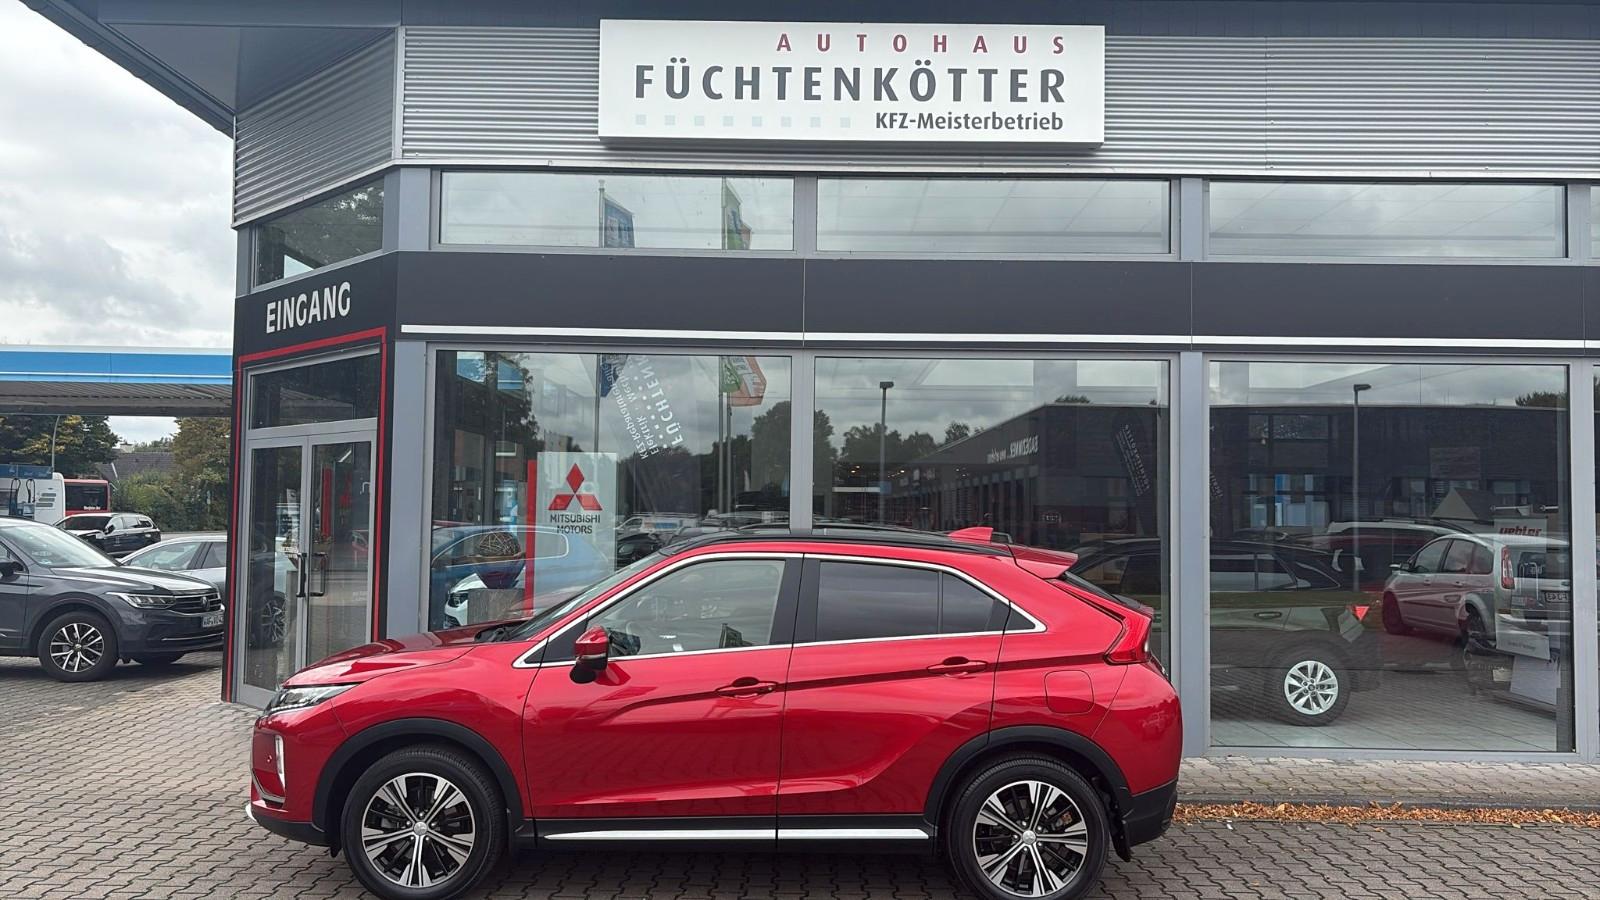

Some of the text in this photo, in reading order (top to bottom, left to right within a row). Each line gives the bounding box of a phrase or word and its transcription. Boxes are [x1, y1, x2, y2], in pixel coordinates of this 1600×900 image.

[776, 33, 1064, 54] AUTOHAUS
[635, 57, 1065, 103] FÜCHTENKÖTTER
[876, 112, 1064, 130] KFZ-Meisterbetrieb
[266, 281, 351, 334] EINGANG
[550, 514, 601, 524] MITSUBISHI
[556, 524, 593, 534] MOTORS
